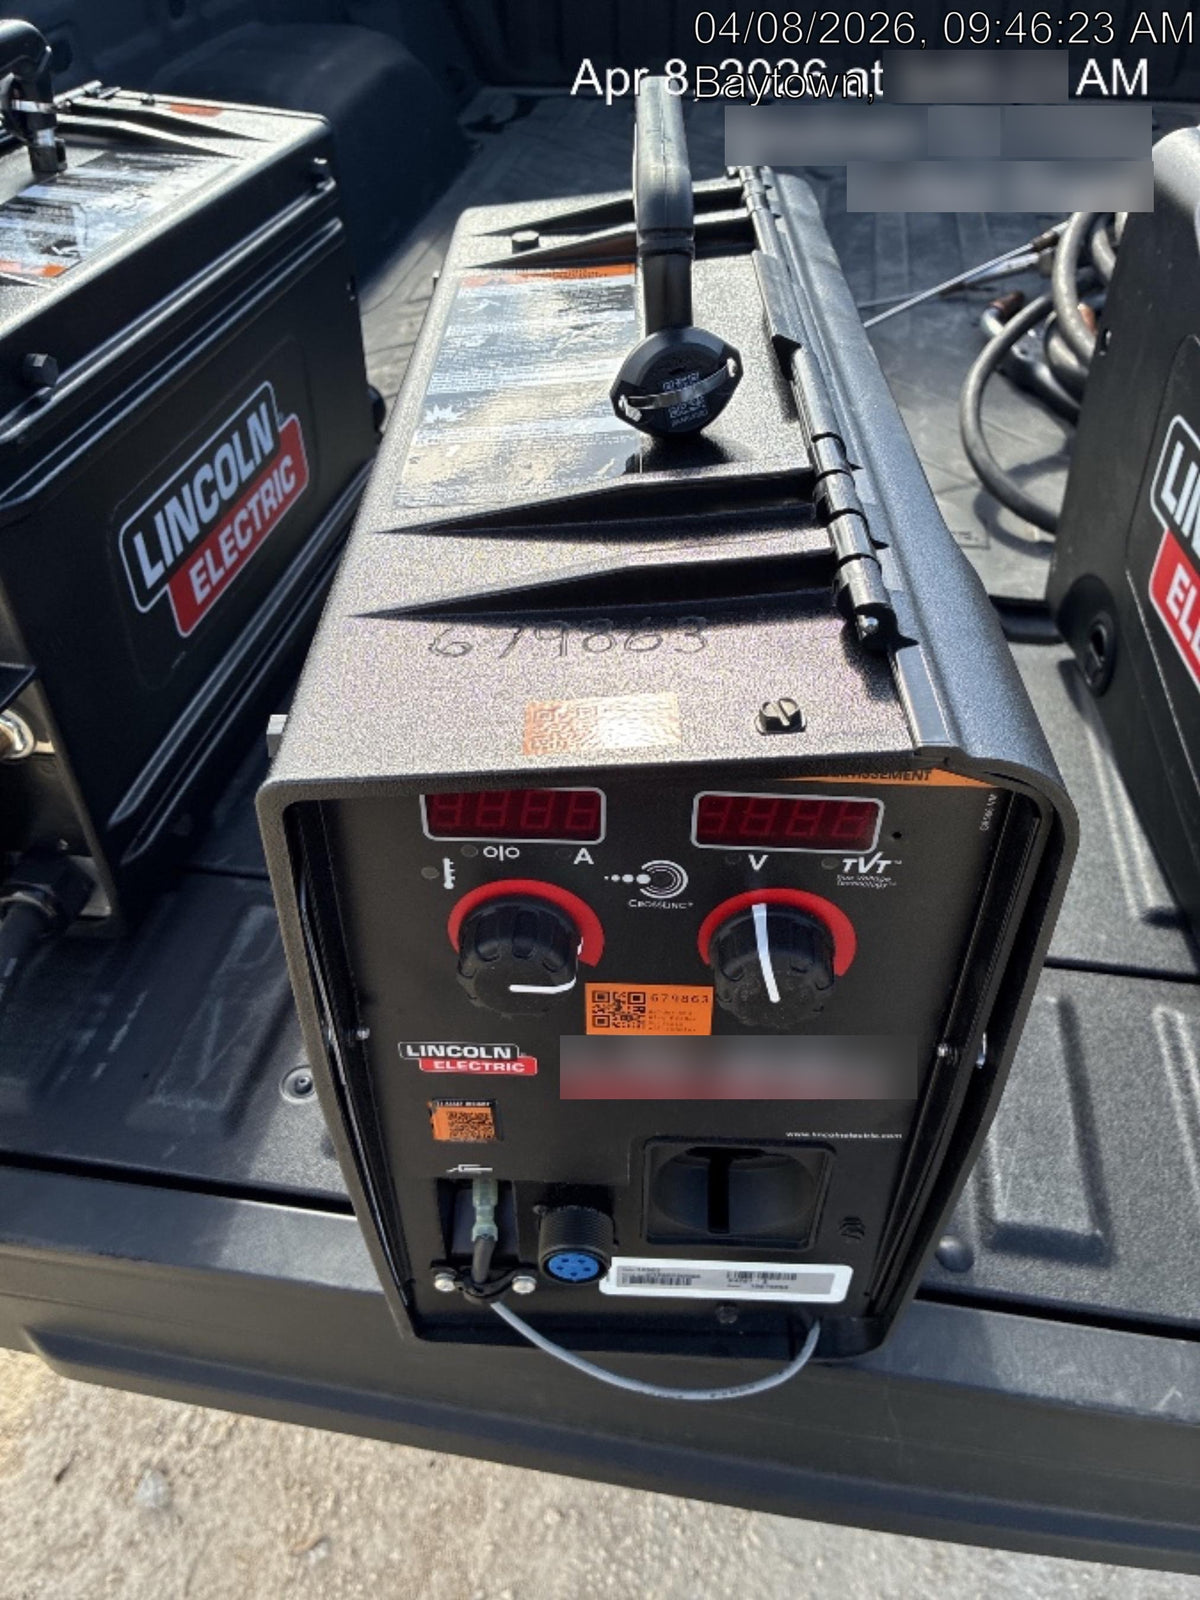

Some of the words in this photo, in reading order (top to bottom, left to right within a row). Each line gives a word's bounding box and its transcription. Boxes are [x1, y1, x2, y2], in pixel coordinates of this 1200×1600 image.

[133, 401, 275, 590] LINCOLN
[189, 454, 297, 606] ELECTRIC
[573, 847, 595, 865] A
[748, 854, 769, 871] V
[406, 1044, 511, 1059] LINCOLN
[433, 1060, 526, 1073] ELECTRIC
